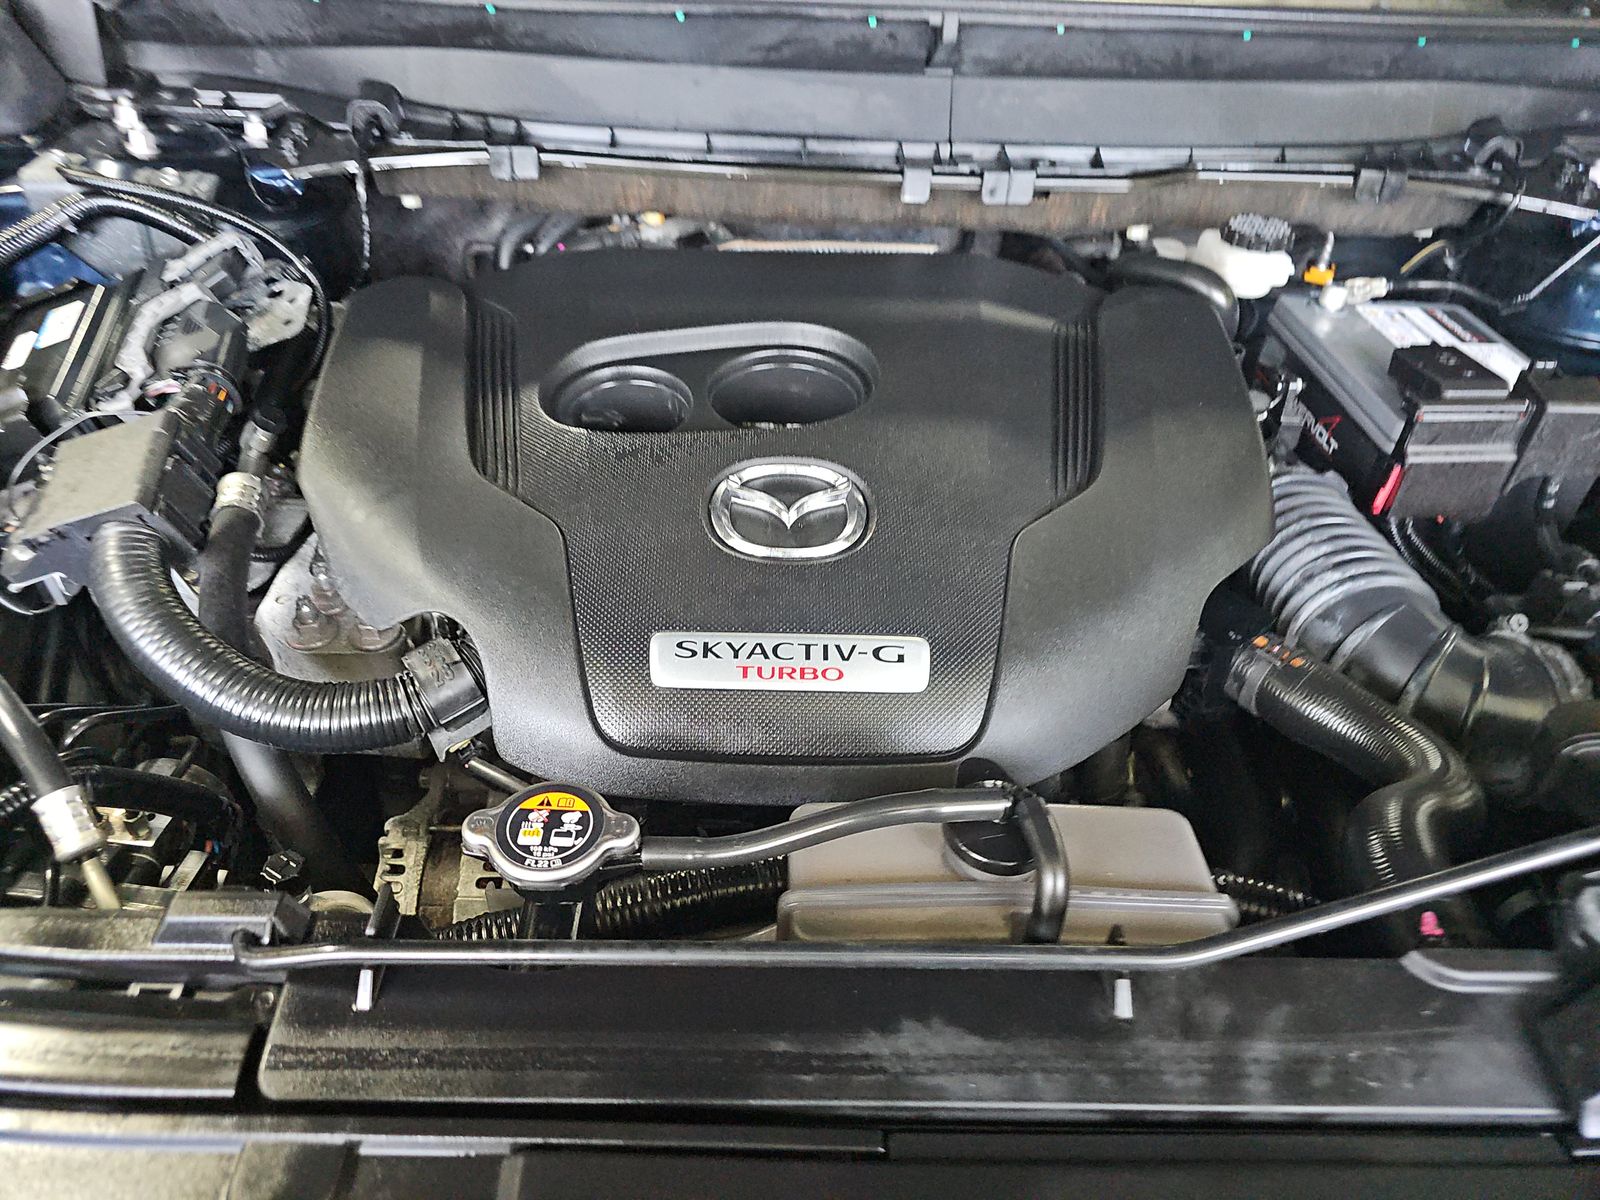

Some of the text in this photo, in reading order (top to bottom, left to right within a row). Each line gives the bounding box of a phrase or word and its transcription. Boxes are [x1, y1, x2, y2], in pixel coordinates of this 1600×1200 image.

[674, 640, 905, 664] SKYACTIV-G
[736, 665, 844, 681] TURBO
[524, 858, 549, 868] FL22
